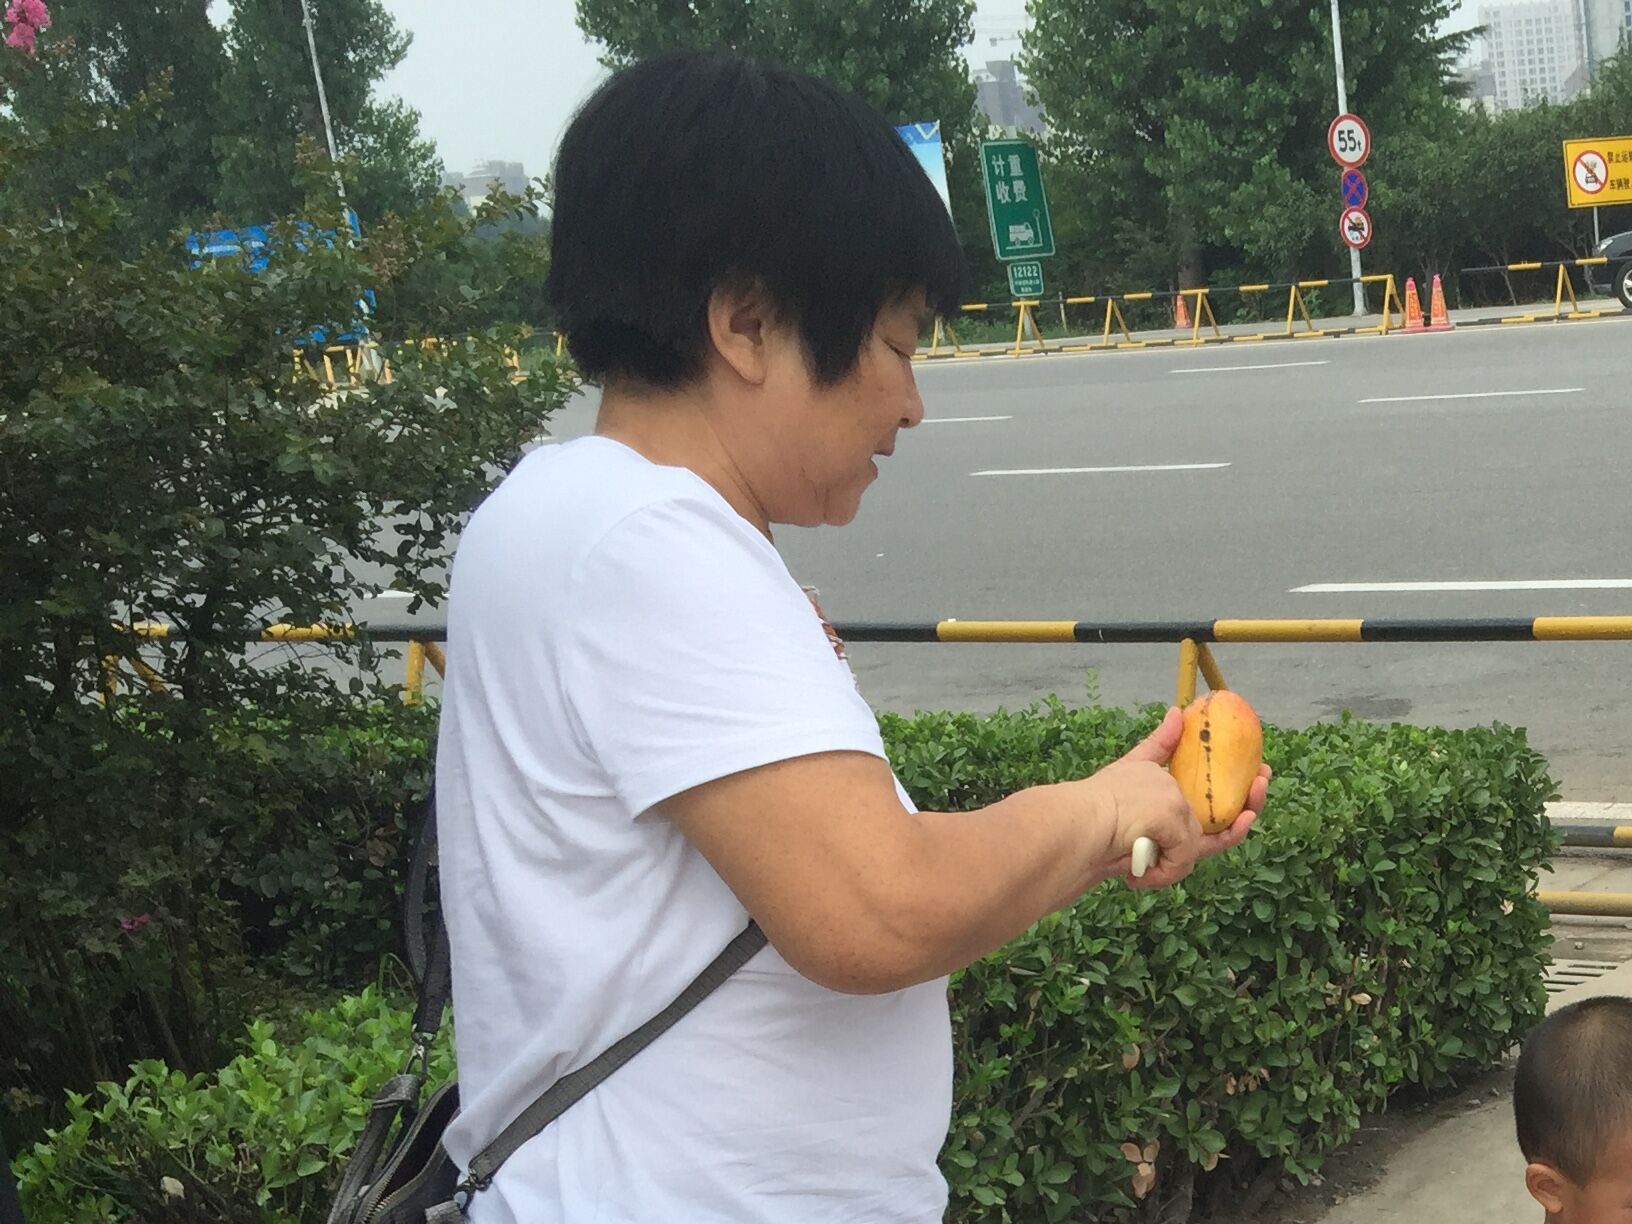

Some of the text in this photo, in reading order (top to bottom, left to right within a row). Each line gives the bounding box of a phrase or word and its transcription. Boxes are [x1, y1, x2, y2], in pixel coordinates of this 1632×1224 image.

[1337, 129, 1362, 153] 55t
[992, 154, 1024, 177] 计重
[995, 179, 1028, 204] 收费
[1013, 265, 1038, 278] 12122
